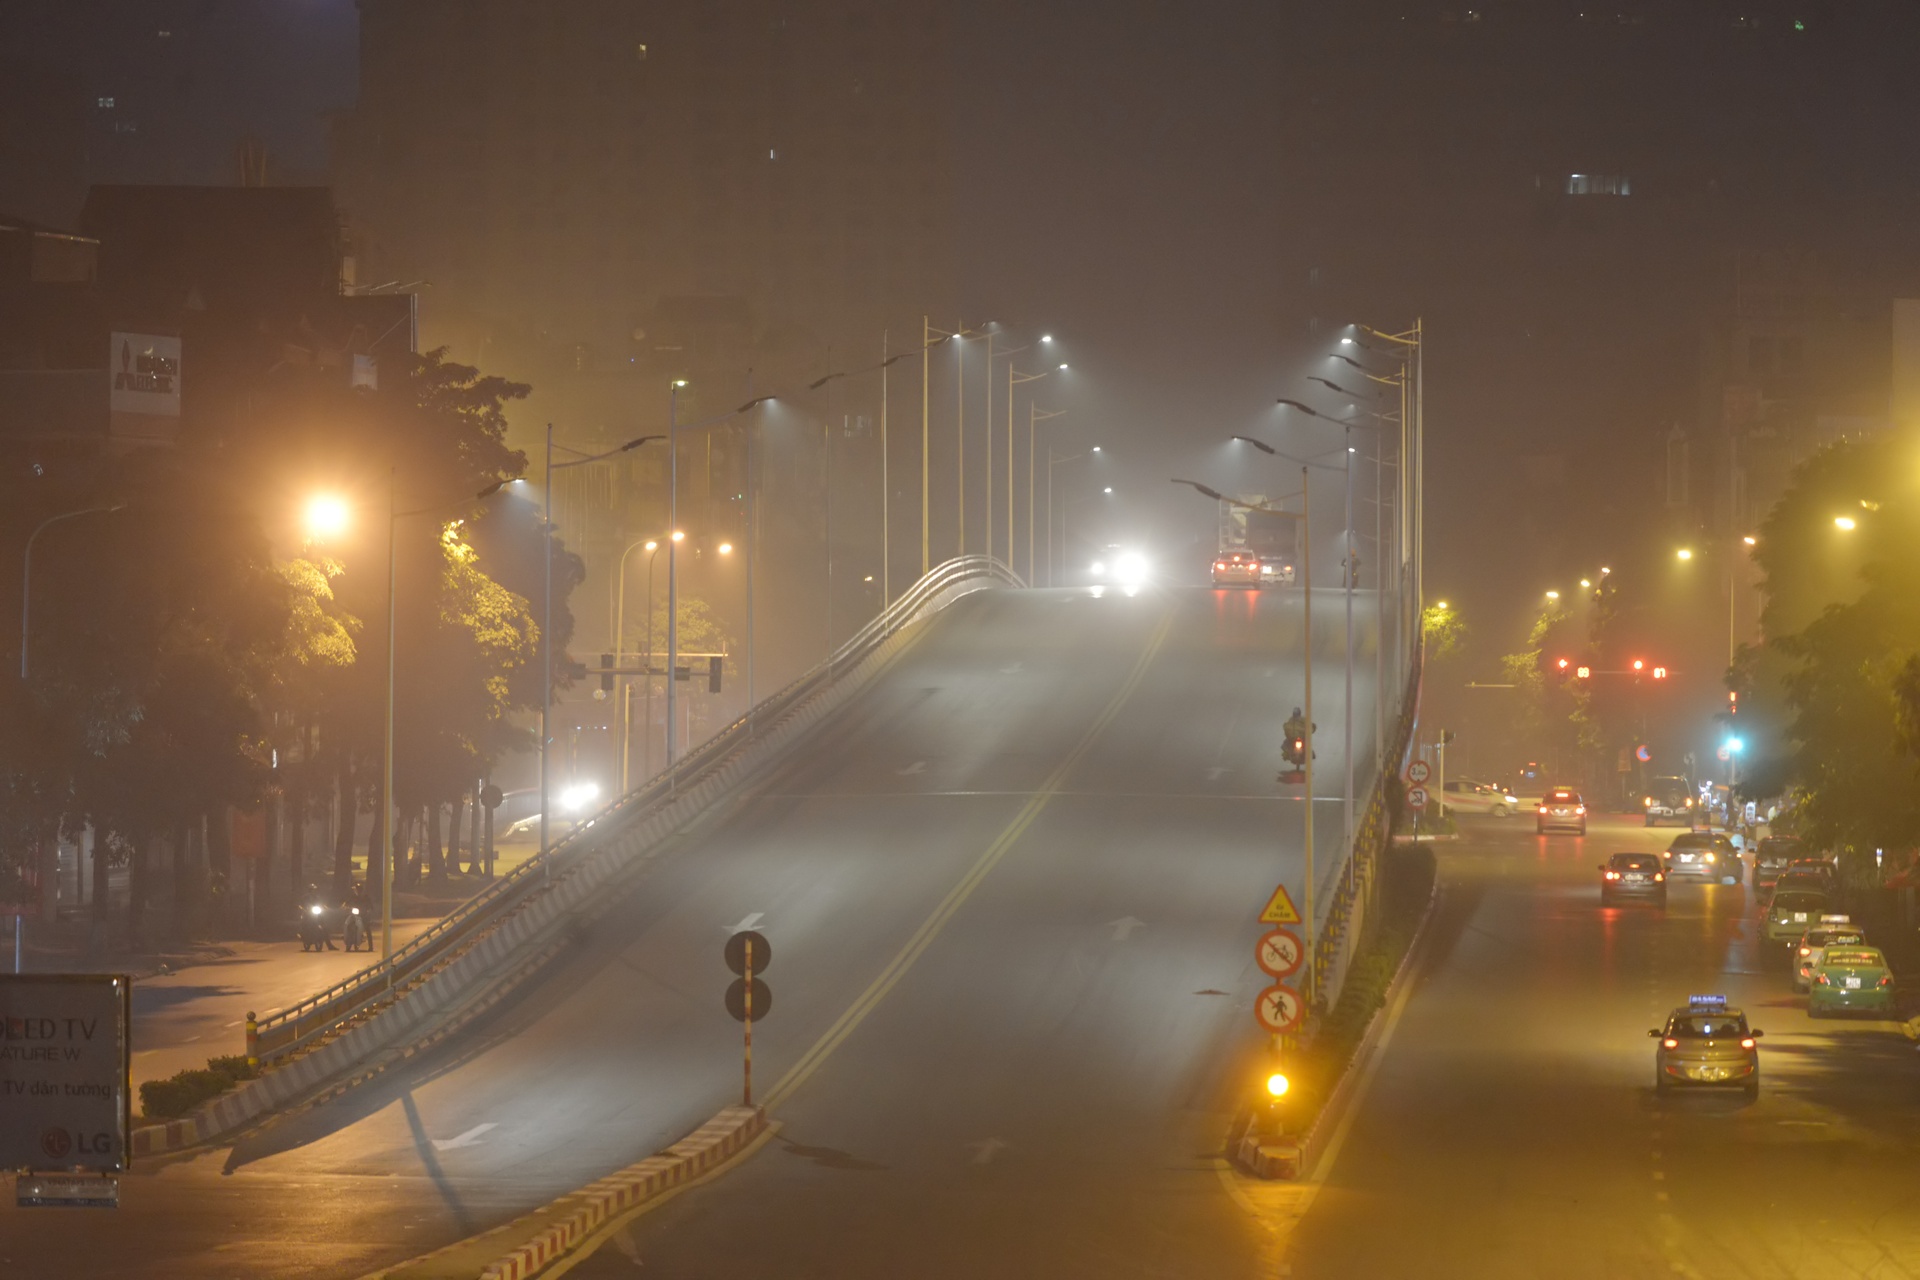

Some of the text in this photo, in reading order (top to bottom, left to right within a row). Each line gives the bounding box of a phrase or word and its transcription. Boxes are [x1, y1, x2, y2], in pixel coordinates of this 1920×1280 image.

[0, 1017, 97, 1040] LED TV
[63, 1047, 81, 1061] W
[4, 1079, 25, 1095] TV
[77, 1132, 111, 1154] LG
